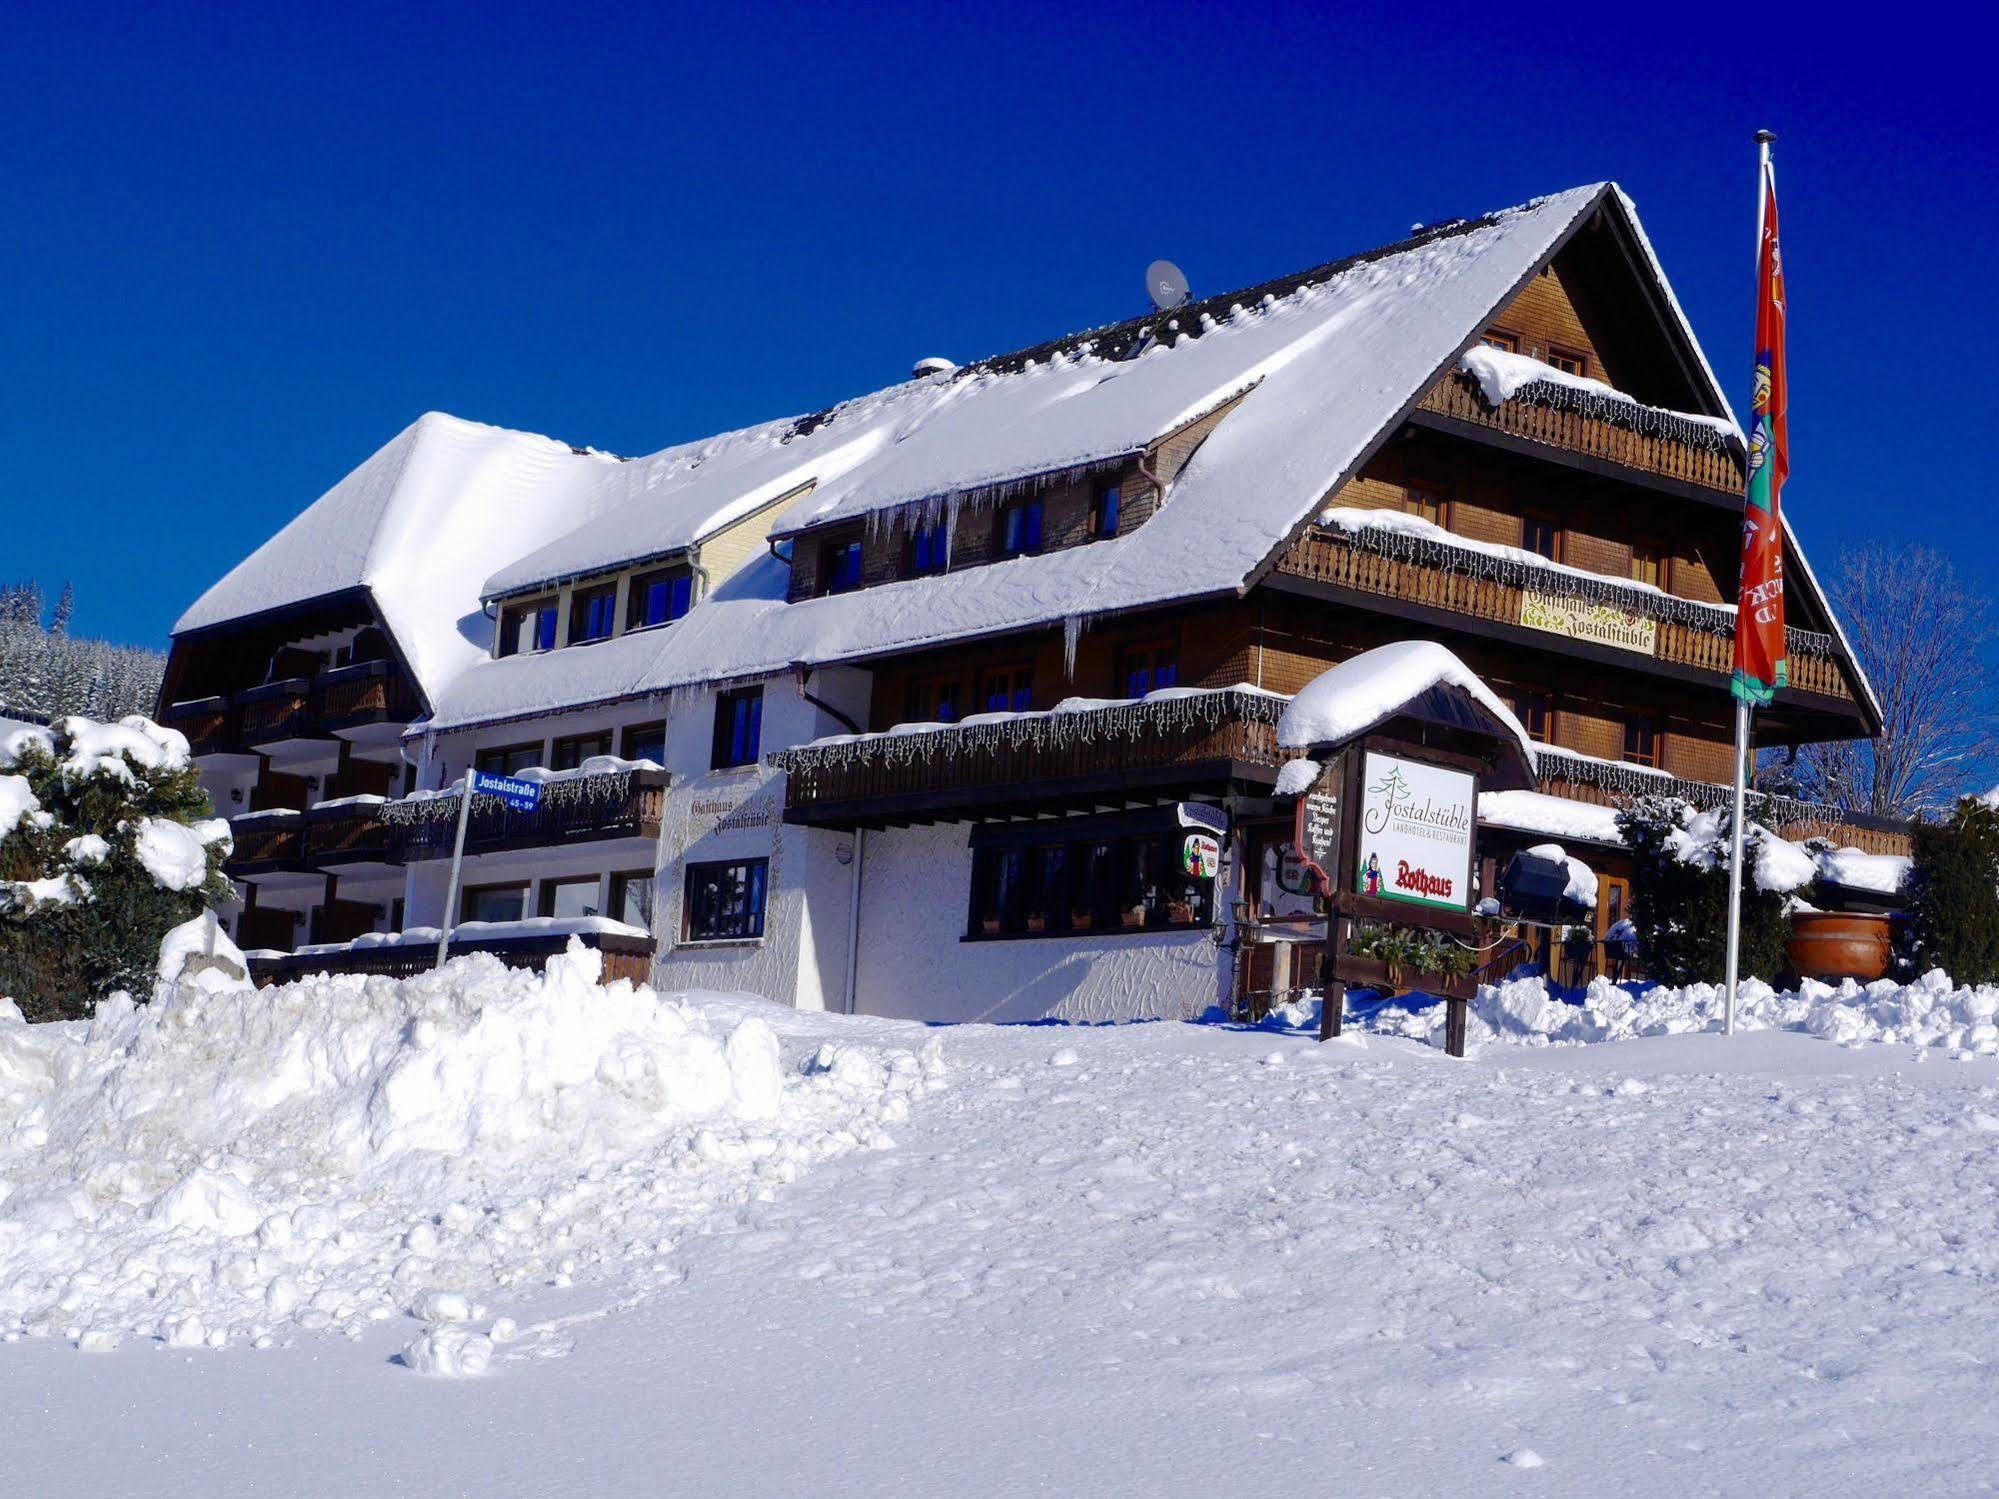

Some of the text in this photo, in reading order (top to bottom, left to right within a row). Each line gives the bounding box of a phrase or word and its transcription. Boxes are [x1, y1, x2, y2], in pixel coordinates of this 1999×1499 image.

[478, 775, 535, 797] Jostalstraße
[1365, 778, 1469, 834] Jostalstüble
[1392, 821, 1426, 838] LANDHOTEL
[1432, 831, 1468, 846] RESTAURANT
[1395, 859, 1453, 898] Rothaus
